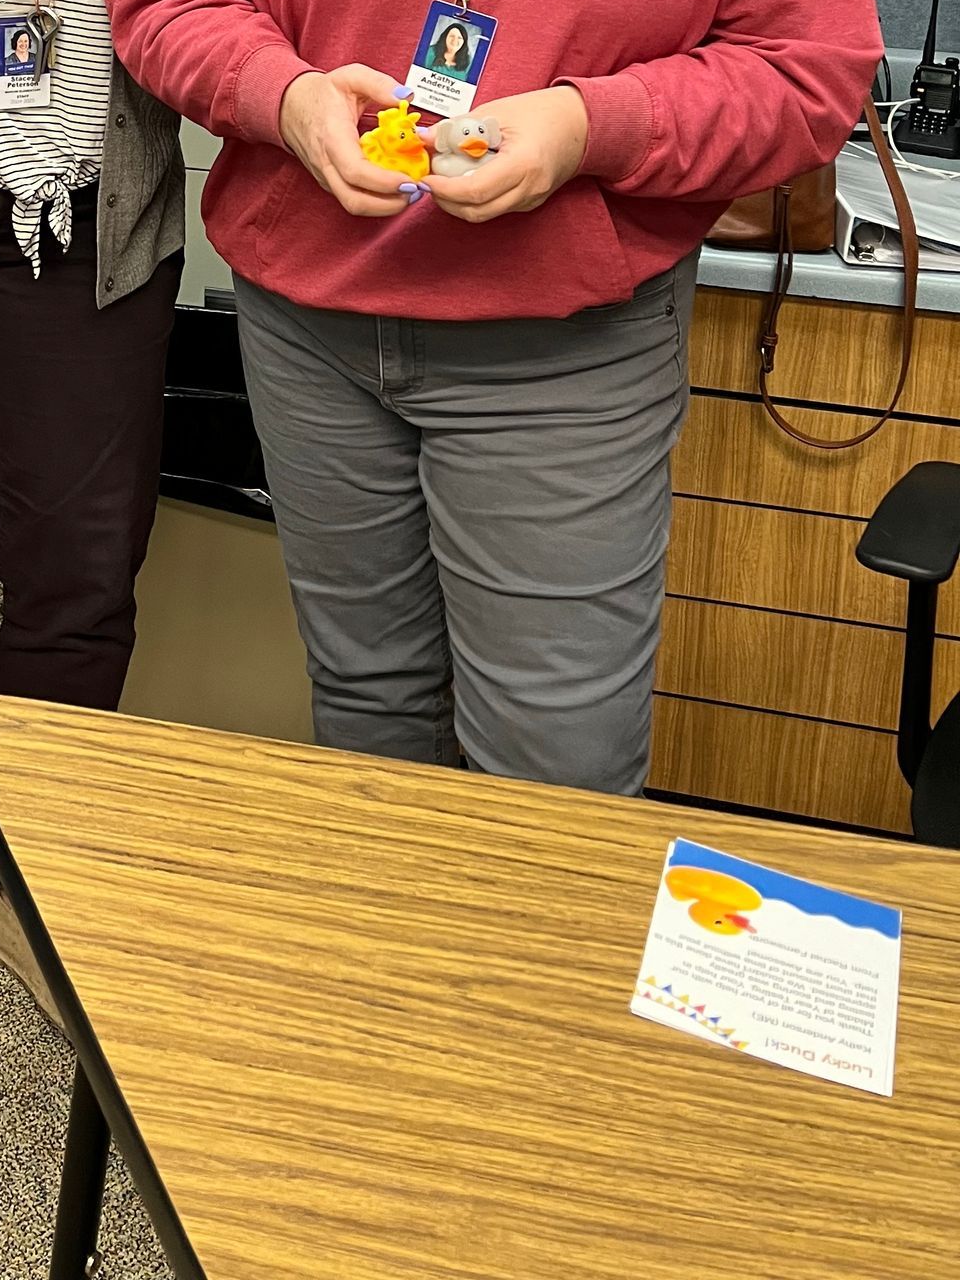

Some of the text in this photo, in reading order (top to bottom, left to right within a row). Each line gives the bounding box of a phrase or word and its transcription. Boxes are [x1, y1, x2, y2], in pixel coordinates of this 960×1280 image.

[421, 77, 460, 95] Anderson
[430, 72, 455, 86] Kathy
[796, 1009, 812, 1019] for
[815, 1014, 835, 1025] you
[782, 1021, 836, 1043] Anderson
[838, 1038, 871, 1054] Kathy
[765, 1037, 873, 1078] Lucky Duck!
